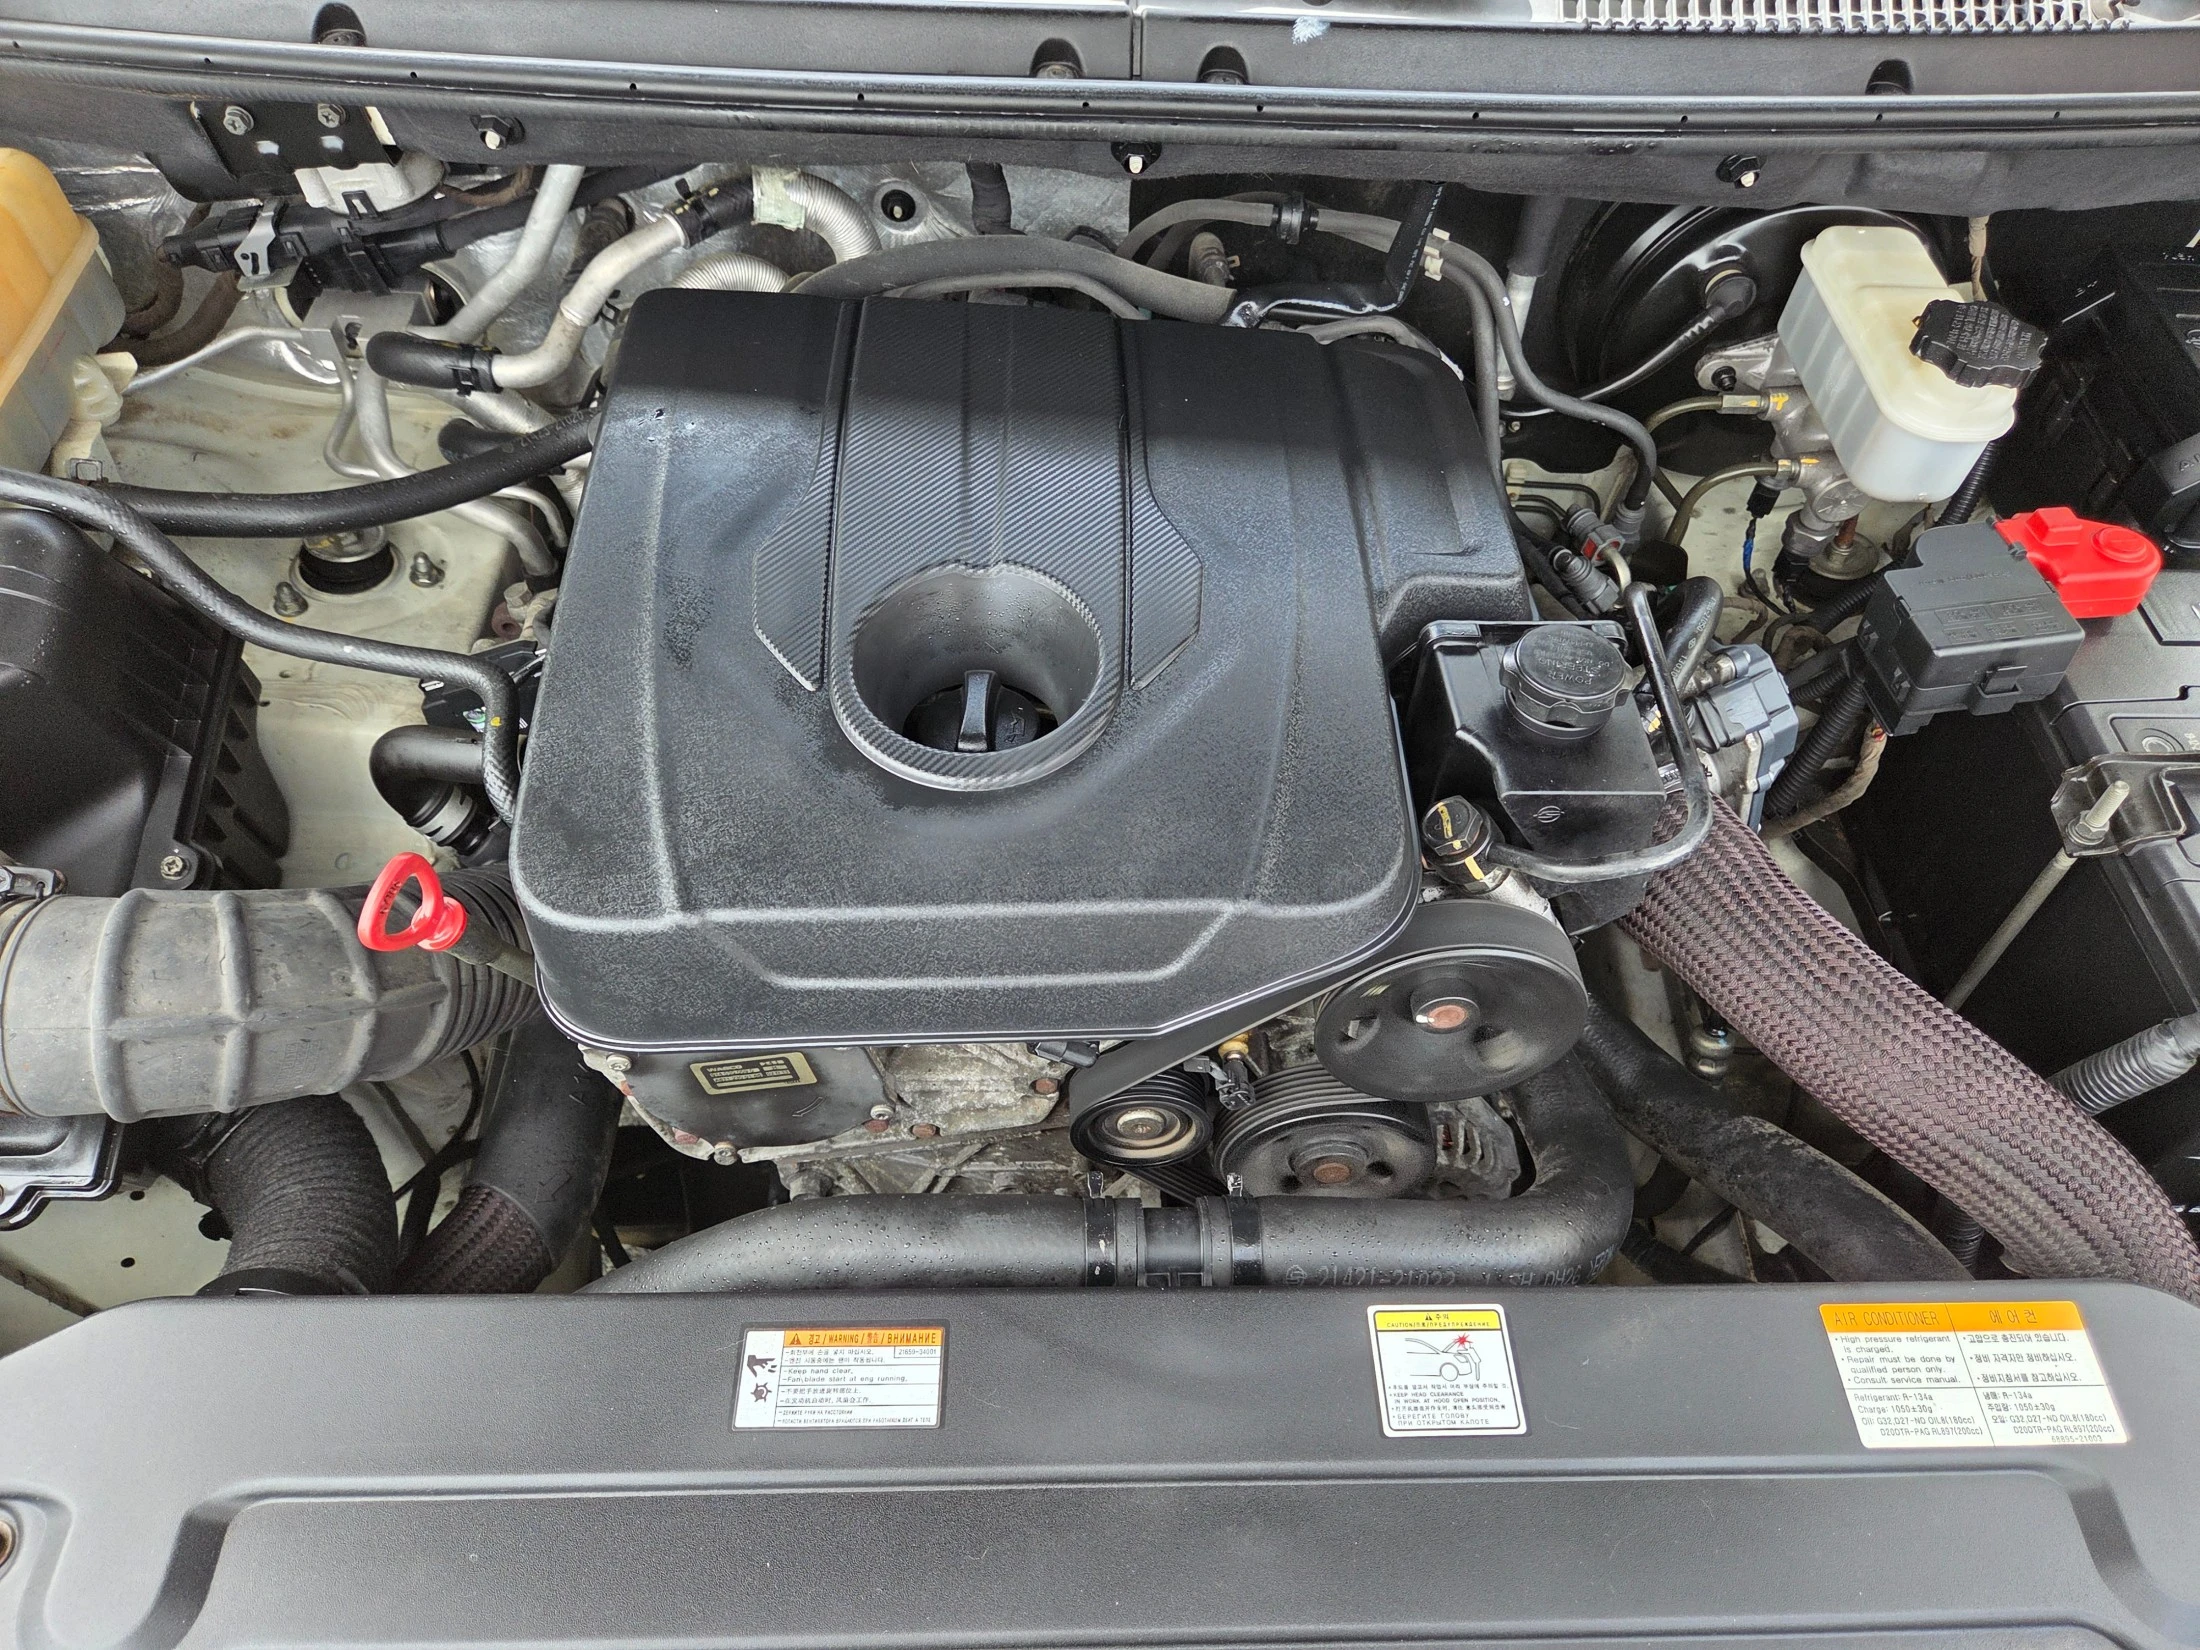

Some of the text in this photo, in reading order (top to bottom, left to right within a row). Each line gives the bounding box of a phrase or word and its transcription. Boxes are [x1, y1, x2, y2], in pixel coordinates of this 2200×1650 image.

[1548, 671, 1592, 685] POWER
[1834, 1310, 1940, 1326] AIR CONDITIONER
[808, 1334, 820, 1345] 경고
[828, 1334, 859, 1344] WARNING
[888, 1332, 936, 1344] ВНИМАНИЕ
[1841, 1336, 1860, 1344] High
[1906, 1335, 1951, 1344] refrigerant
[1856, 1344, 1894, 1354] charged.
[1847, 1356, 1874, 1364] Repair
[1920, 1355, 1942, 1363] done
[1945, 1355, 1955, 1364] by
[1850, 1366, 1888, 1374] qualified
[1926, 1366, 1946, 1374] only.
[1854, 1376, 1888, 1384] Consult
[1854, 1393, 1934, 1402] Refrigerant: R-134a
[2002, 1391, 2032, 1400] R-134a
[1858, 1404, 1934, 1414] Charge: 1050±30g
[2014, 1402, 2056, 1412] 1050±30g
